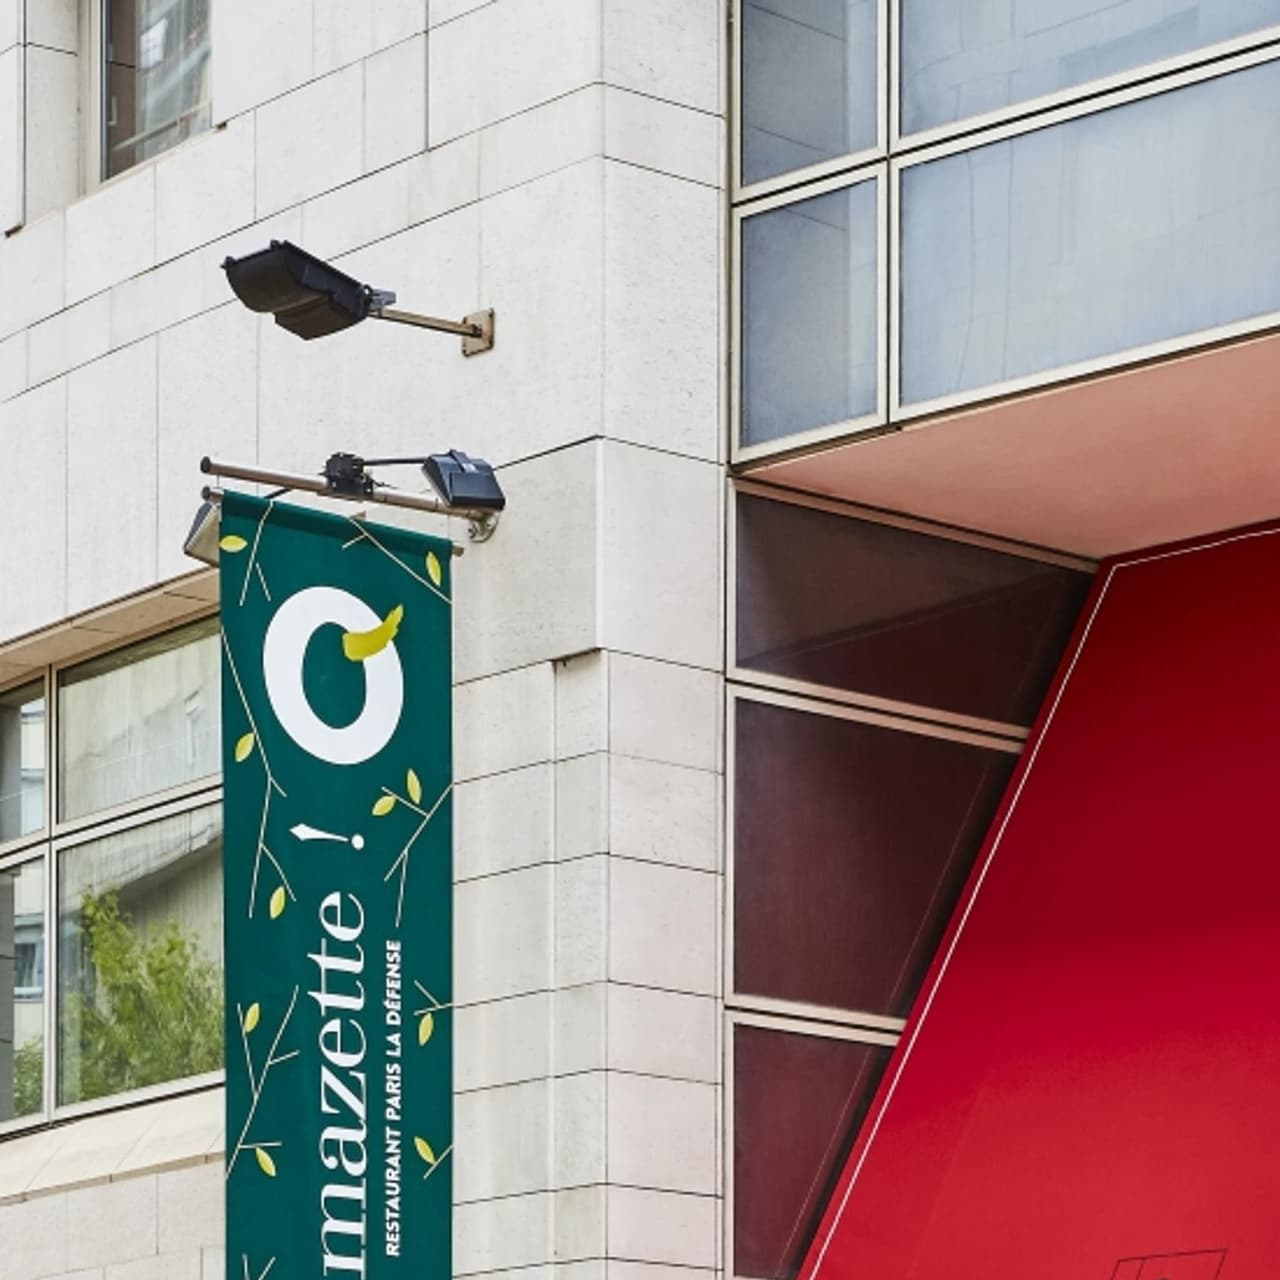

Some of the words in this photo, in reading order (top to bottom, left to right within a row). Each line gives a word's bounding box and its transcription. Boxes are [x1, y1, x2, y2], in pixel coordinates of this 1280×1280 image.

[382, 940, 401, 1025] DÉFENSE
[307, 890, 368, 1280] mazette
[384, 1034, 401, 1058] LA
[384, 1063, 401, 1121] PARIS
[384, 1127, 401, 1257] RESTAURANT
